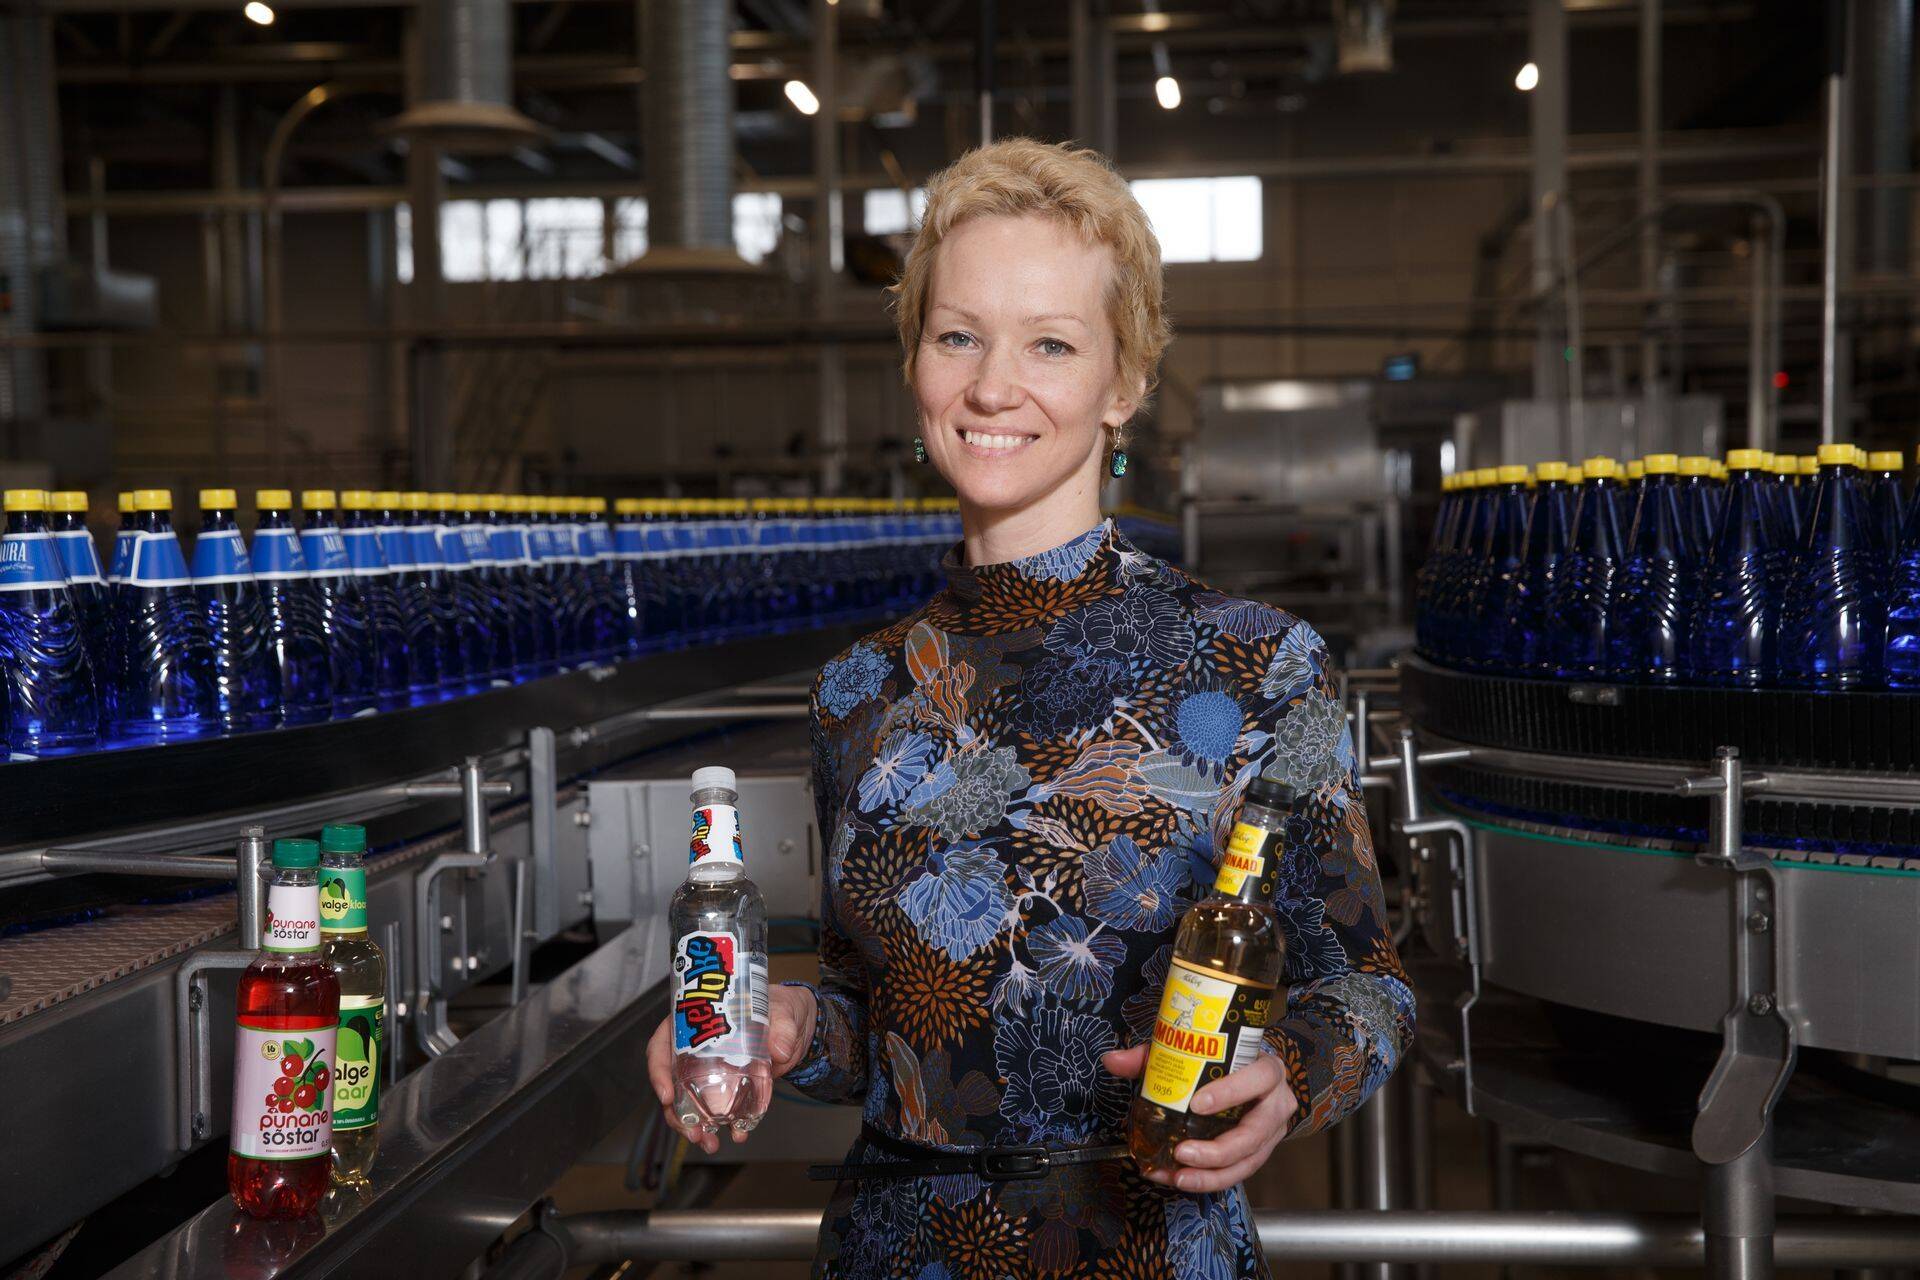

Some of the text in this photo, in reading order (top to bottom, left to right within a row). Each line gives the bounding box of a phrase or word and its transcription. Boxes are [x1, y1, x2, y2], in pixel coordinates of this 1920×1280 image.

[322, 900, 348, 912] valge
[273, 919, 316, 931] punane
[274, 928, 310, 940] sõstar
[677, 937, 730, 1047] kelluke
[1153, 1082, 1173, 1097] 1936
[260, 1109, 329, 1131] punane
[262, 1128, 320, 1146] sõstar
